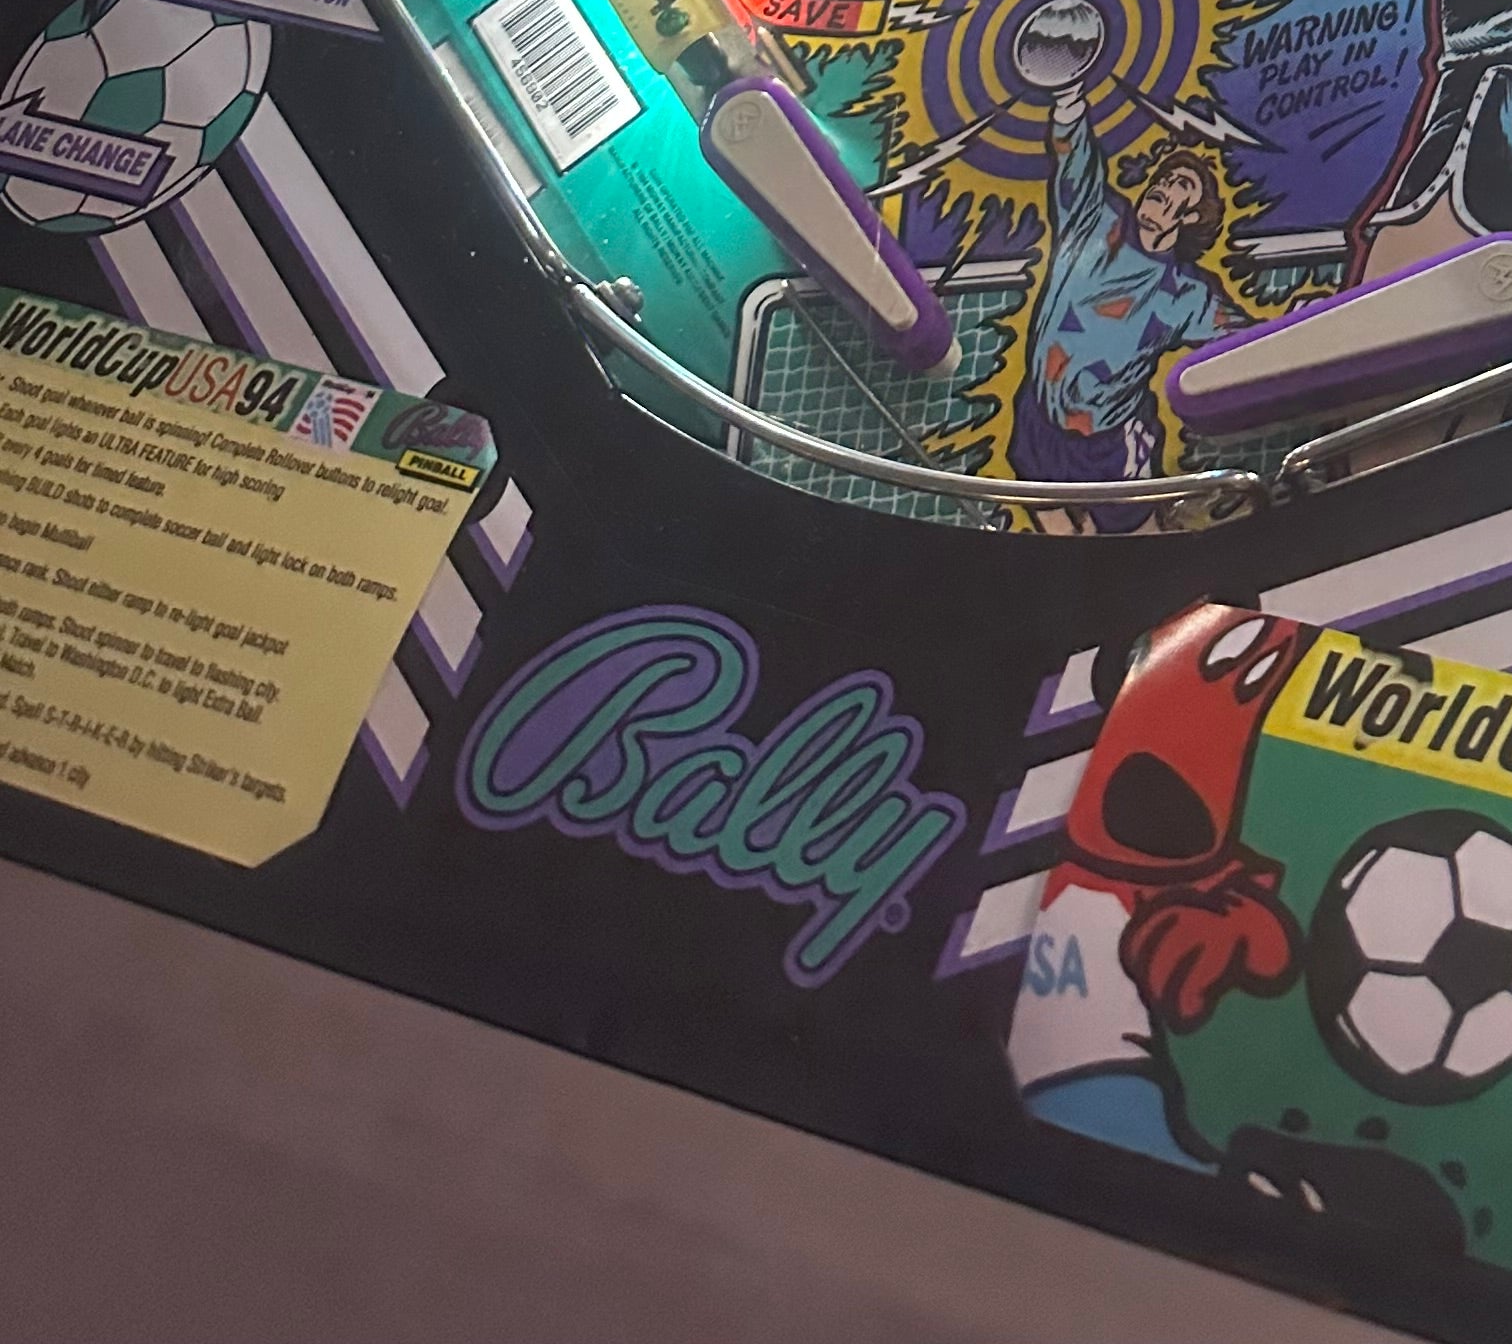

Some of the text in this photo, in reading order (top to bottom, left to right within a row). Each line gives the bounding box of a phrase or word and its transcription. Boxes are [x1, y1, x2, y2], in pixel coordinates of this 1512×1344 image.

[1255, 48, 1410, 126] CONTROL!
[1258, 38, 1377, 92] PLAY IN
[0, 117, 152, 176] ANE CHANGE
[9, 376, 43, 398] Shoot
[41, 388, 70, 405] goal
[119, 406, 146, 426] ball
[141, 414, 155, 430] is
[211, 433, 265, 461] Complete
[265, 448, 316, 476] Rollover
[315, 462, 360, 490] buttons
[360, 475, 375, 493] to
[376, 482, 416, 507] relight
[23, 414, 53, 432] goal
[50, 418, 84, 443] lights
[82, 430, 99, 445] an
[100, 432, 139, 455] ULTRA
[141, 443, 195, 472] FEATURE
[193, 459, 211, 477] for
[212, 464, 240, 487] high
[240, 476, 285, 502] scoring
[75, 457, 92, 474] for
[409, 455, 468, 480] PINBALL
[26, 476, 66, 500] BUILD
[63, 488, 97, 510] shots
[96, 497, 110, 514] to
[110, 503, 163, 529] complete
[162, 516, 202, 539] soccer
[201, 527, 228, 549] ball
[226, 537, 252, 557] and
[250, 542, 283, 566] light
[281, 550, 309, 571] lock
[308, 561, 326, 577] on
[325, 565, 356, 586] both
[464, 612, 958, 976] Bally
[1020, 933, 1088, 999] SA
